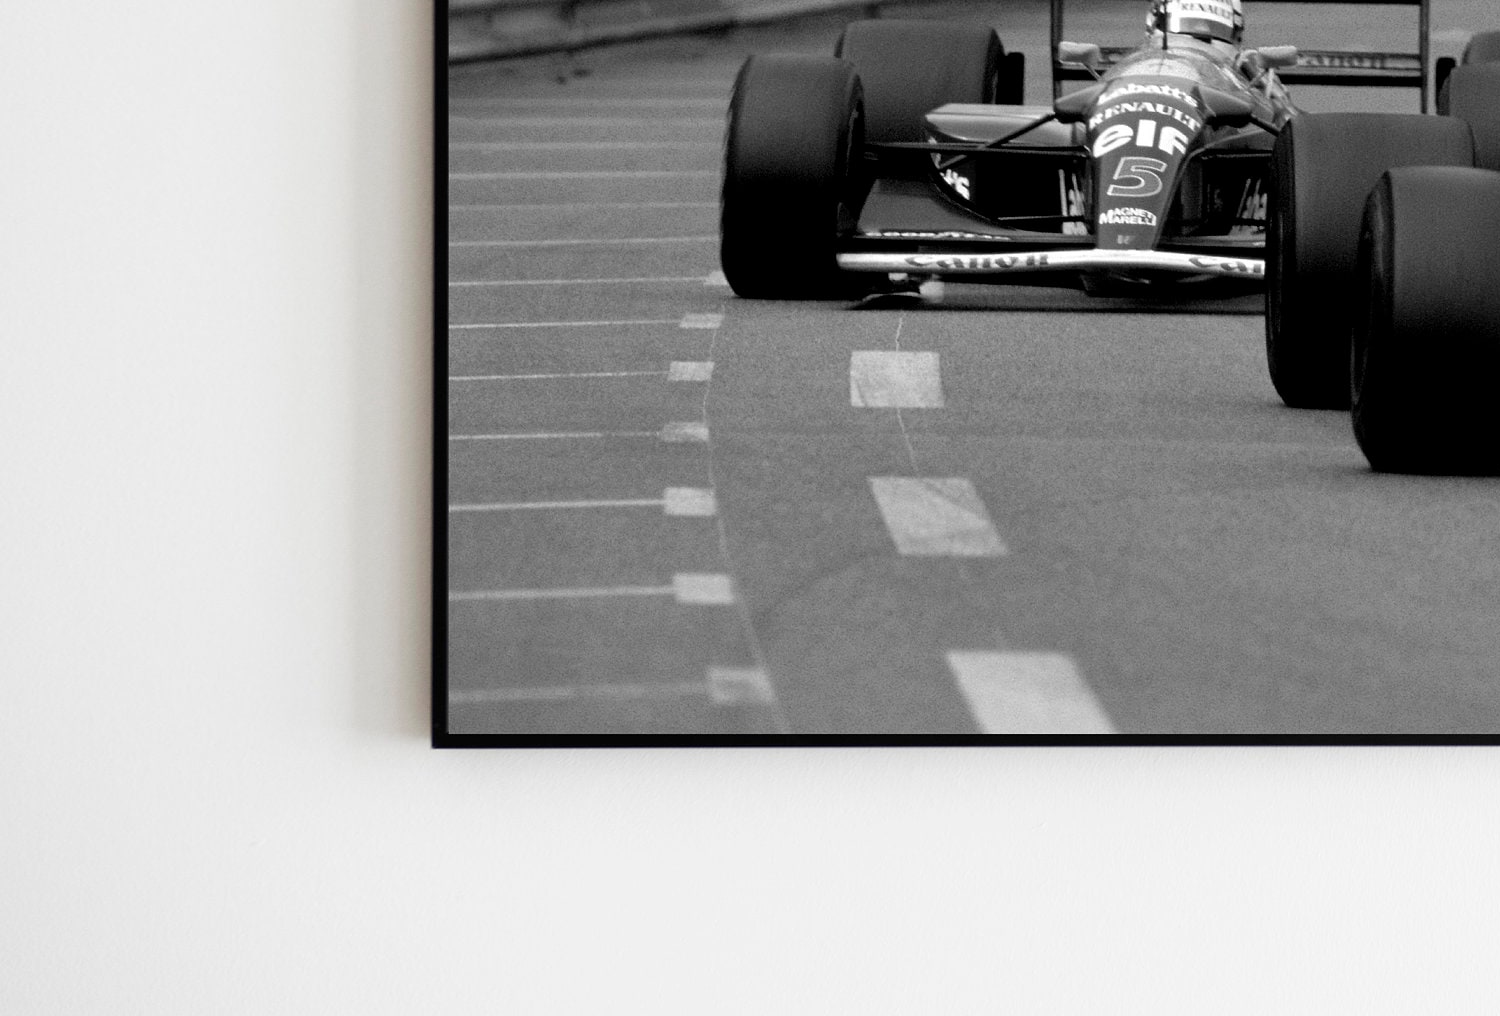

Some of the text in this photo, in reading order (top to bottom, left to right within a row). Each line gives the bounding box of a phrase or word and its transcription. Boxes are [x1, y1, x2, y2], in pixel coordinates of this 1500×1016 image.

[1297, 52, 1385, 70] anon
[1089, 102, 1201, 132] RENAULT
[1093, 119, 1189, 158] elf
[1106, 156, 1168, 198] 5
[904, 254, 1049, 270] Canon
